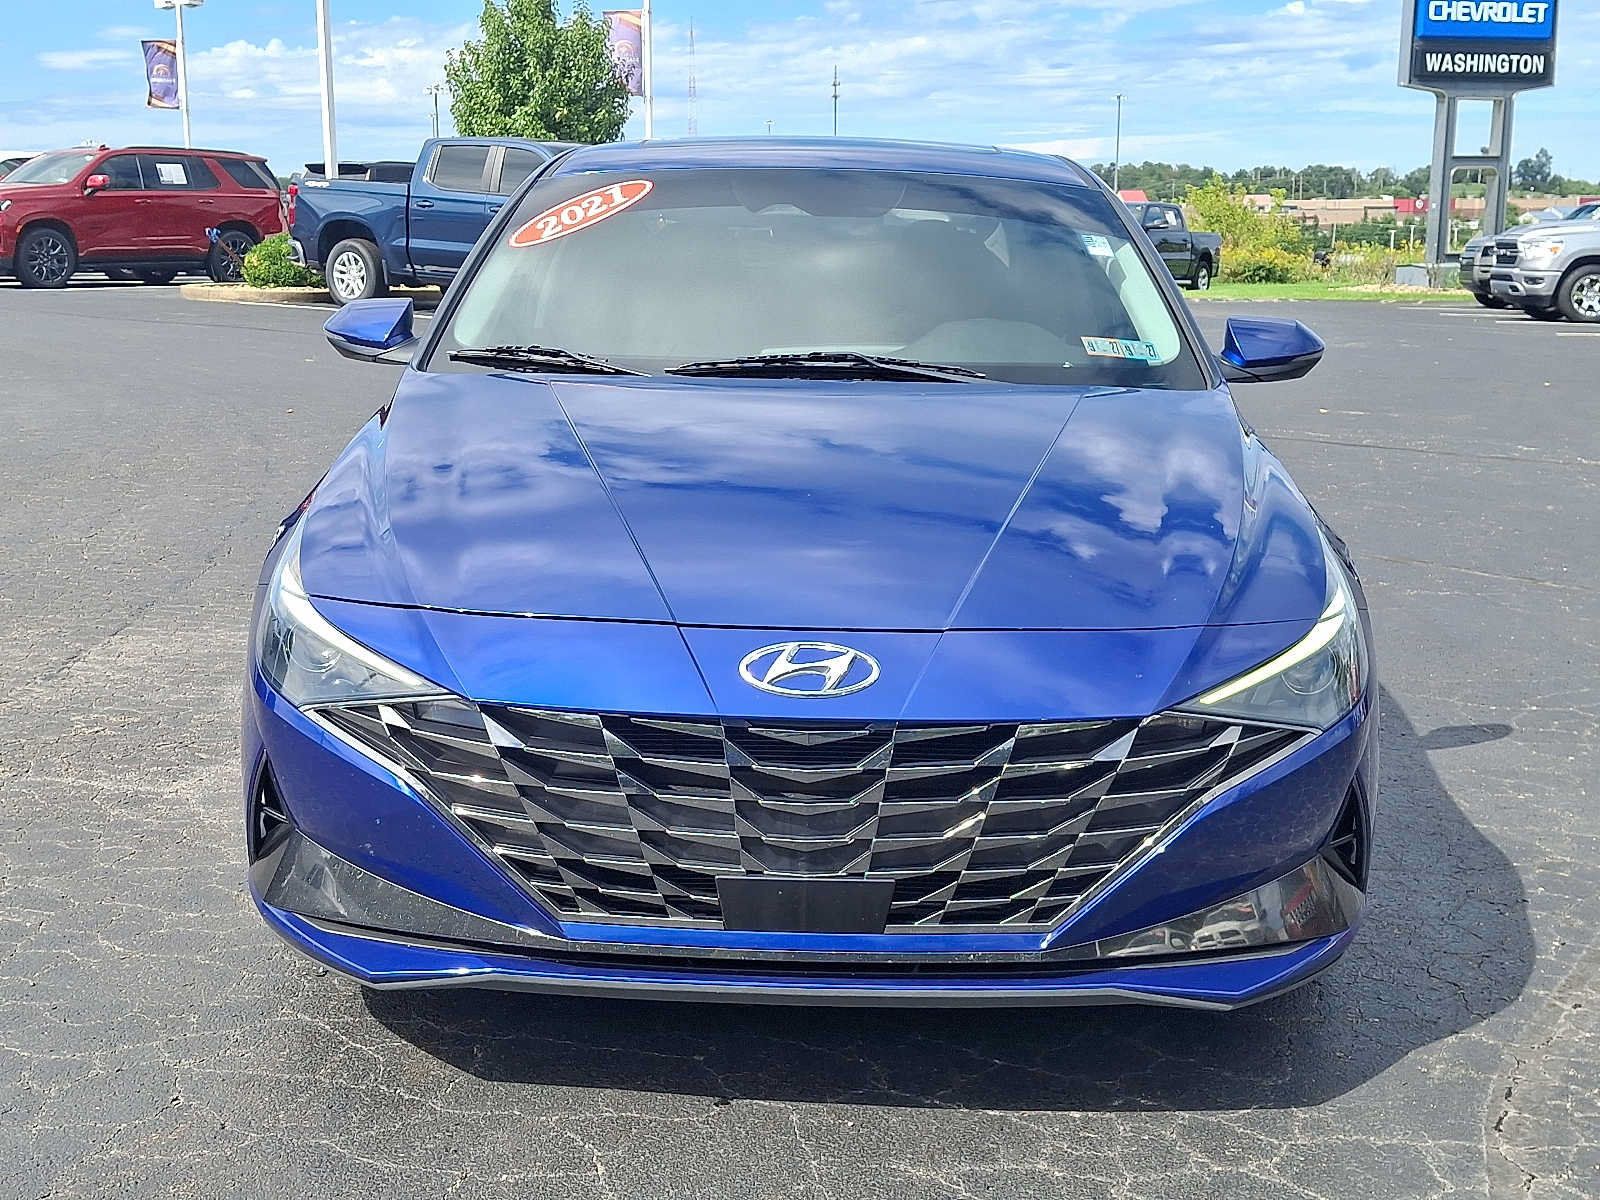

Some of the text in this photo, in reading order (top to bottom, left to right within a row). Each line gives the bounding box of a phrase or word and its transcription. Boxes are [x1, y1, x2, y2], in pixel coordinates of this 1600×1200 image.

[1428, 0, 1549, 24] CHEVROLET
[1425, 53, 1545, 74] WASHINGTON
[536, 185, 630, 239] 2021
